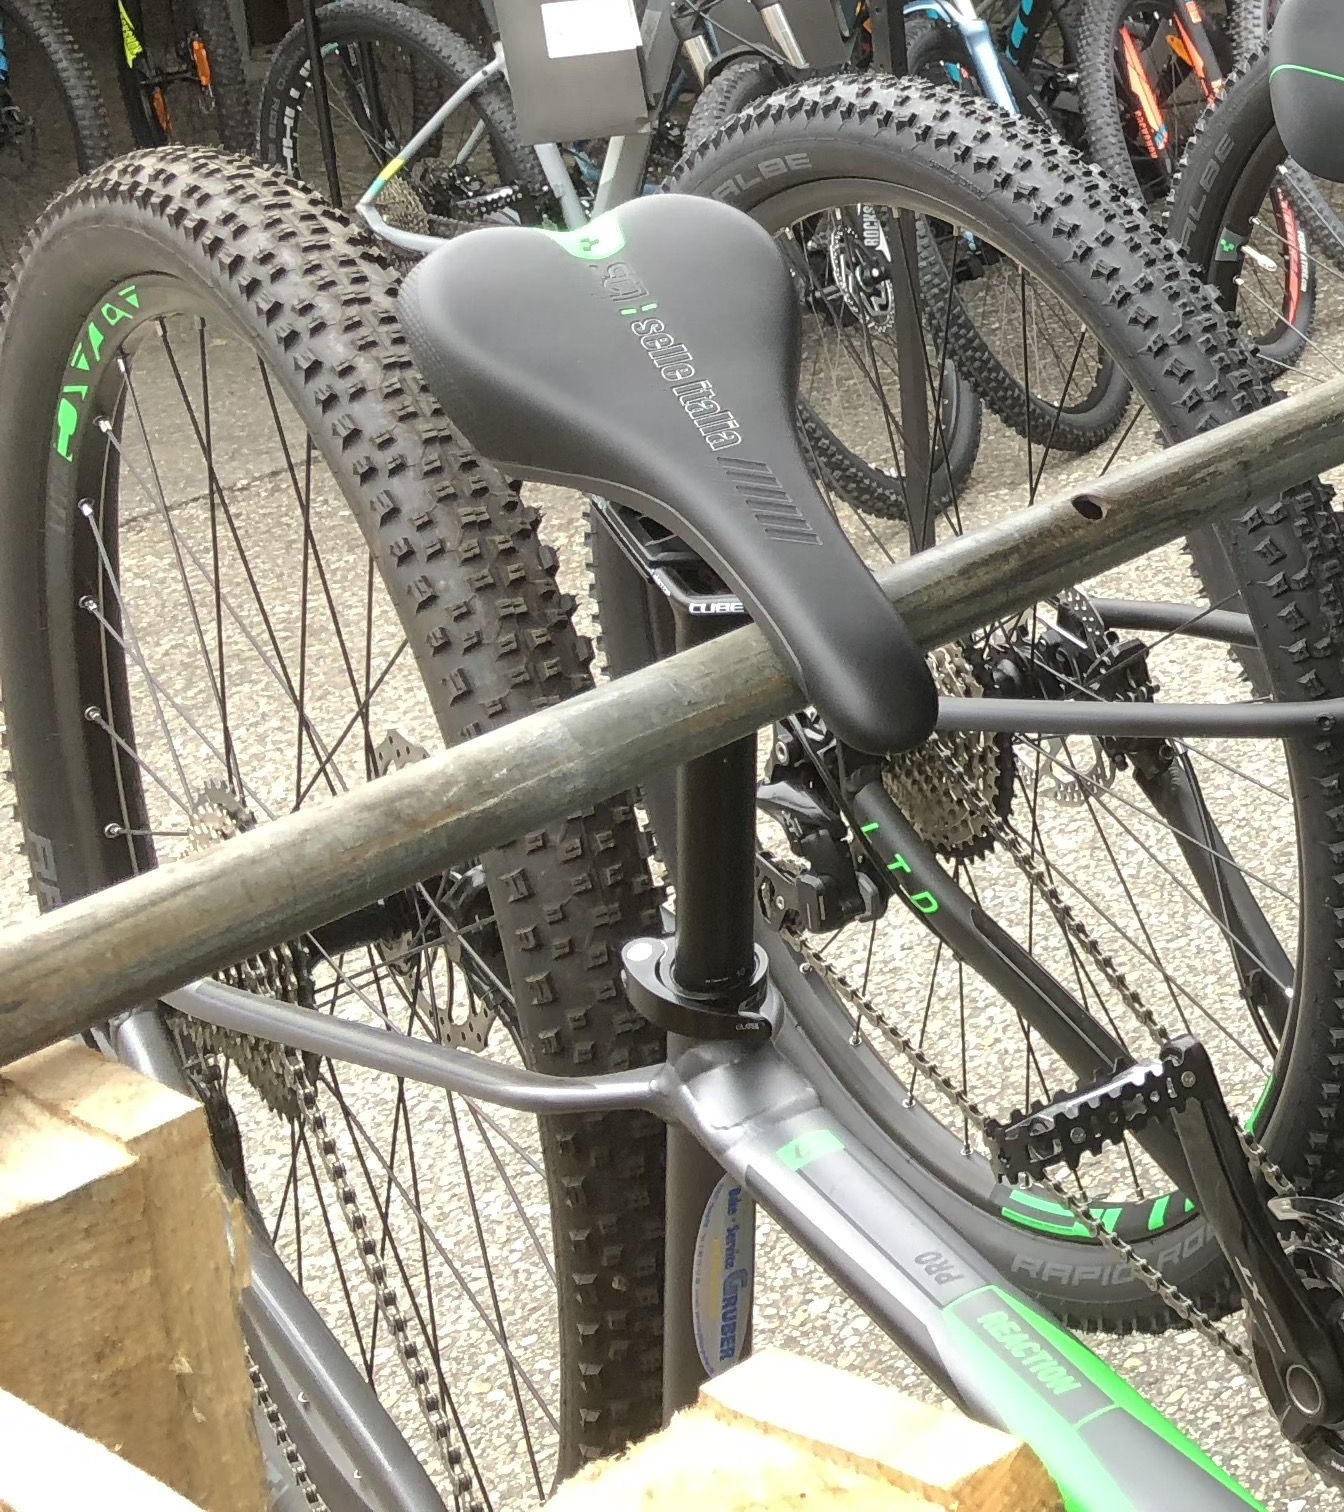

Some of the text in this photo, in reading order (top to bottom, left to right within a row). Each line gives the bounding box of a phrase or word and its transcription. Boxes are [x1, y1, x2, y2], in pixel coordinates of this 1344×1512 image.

[712, 152, 813, 203] ALBE
[862, 201, 881, 247] ROCKS
[631, 318, 742, 441] selle italia
[859, 821, 939, 914] LTD
[914, 1250, 963, 1287] PRO
[718, 1268, 749, 1361] GRUBER
[976, 1308, 1082, 1396] REACTION
